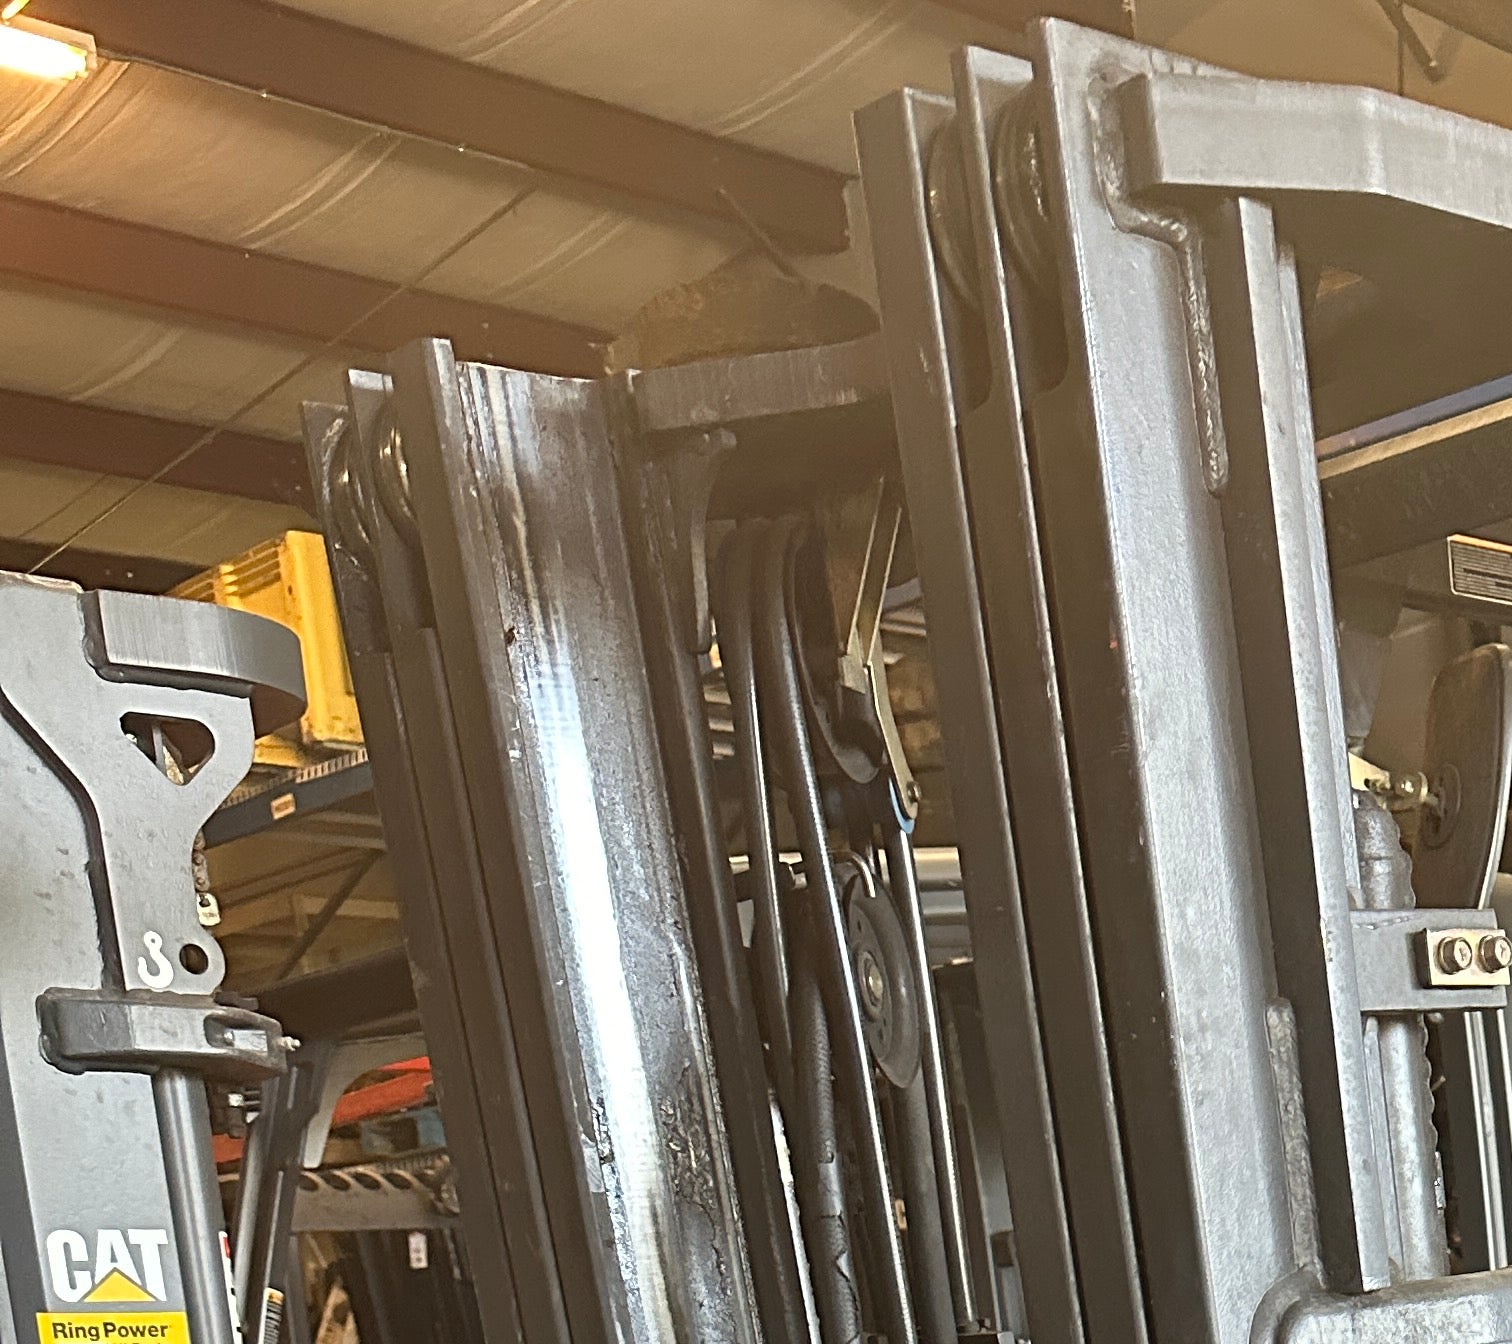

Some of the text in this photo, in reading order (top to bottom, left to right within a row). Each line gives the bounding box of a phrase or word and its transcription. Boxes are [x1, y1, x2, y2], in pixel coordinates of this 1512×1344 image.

[46, 1228, 168, 1303] CAT
[51, 1321, 169, 1342] Ring Power
